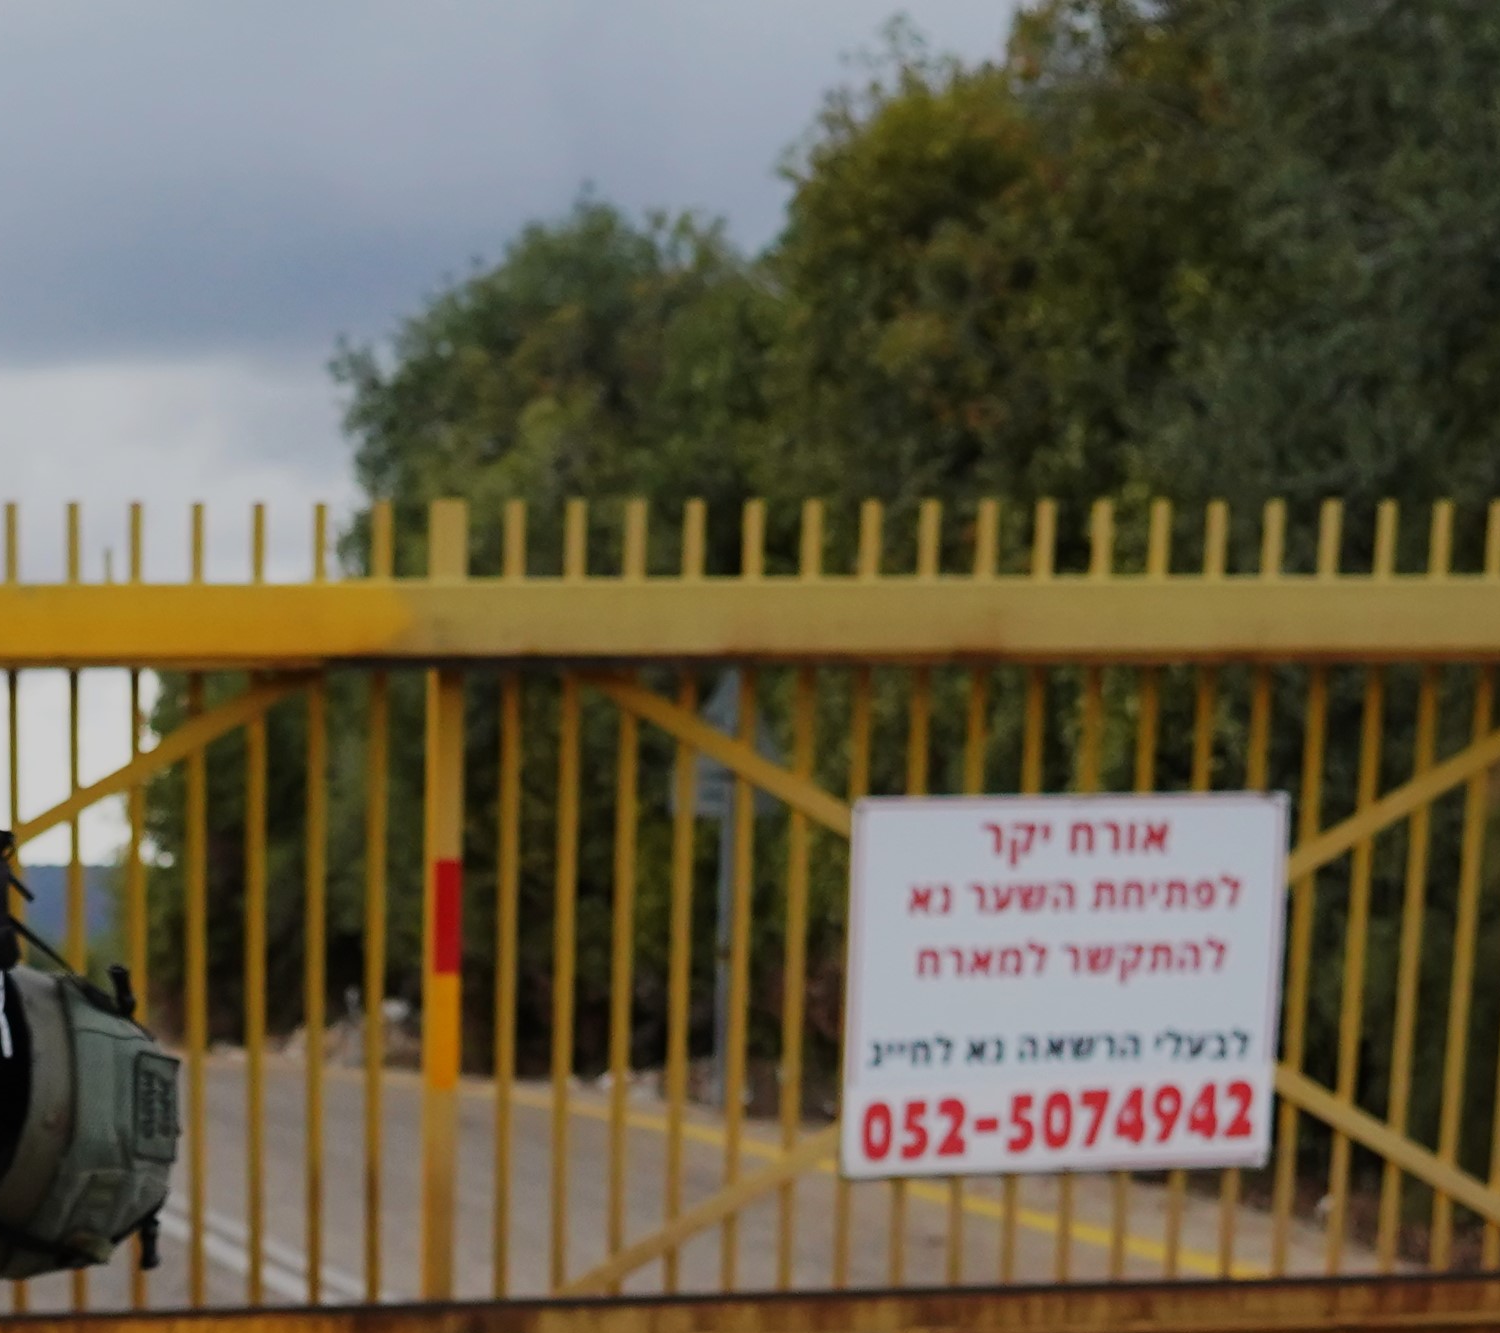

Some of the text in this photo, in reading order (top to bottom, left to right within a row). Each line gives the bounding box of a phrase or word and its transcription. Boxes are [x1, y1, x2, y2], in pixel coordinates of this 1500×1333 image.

[981, 820, 1171, 867] אורח יקר
[908, 873, 1243, 916] לפתיחת השער נא
[915, 936, 1228, 984] להתקשר למארח
[869, 1029, 1251, 1069] לבעלי הרשאה נא לחייג
[861, 1079, 1255, 1162] 052-5074942
